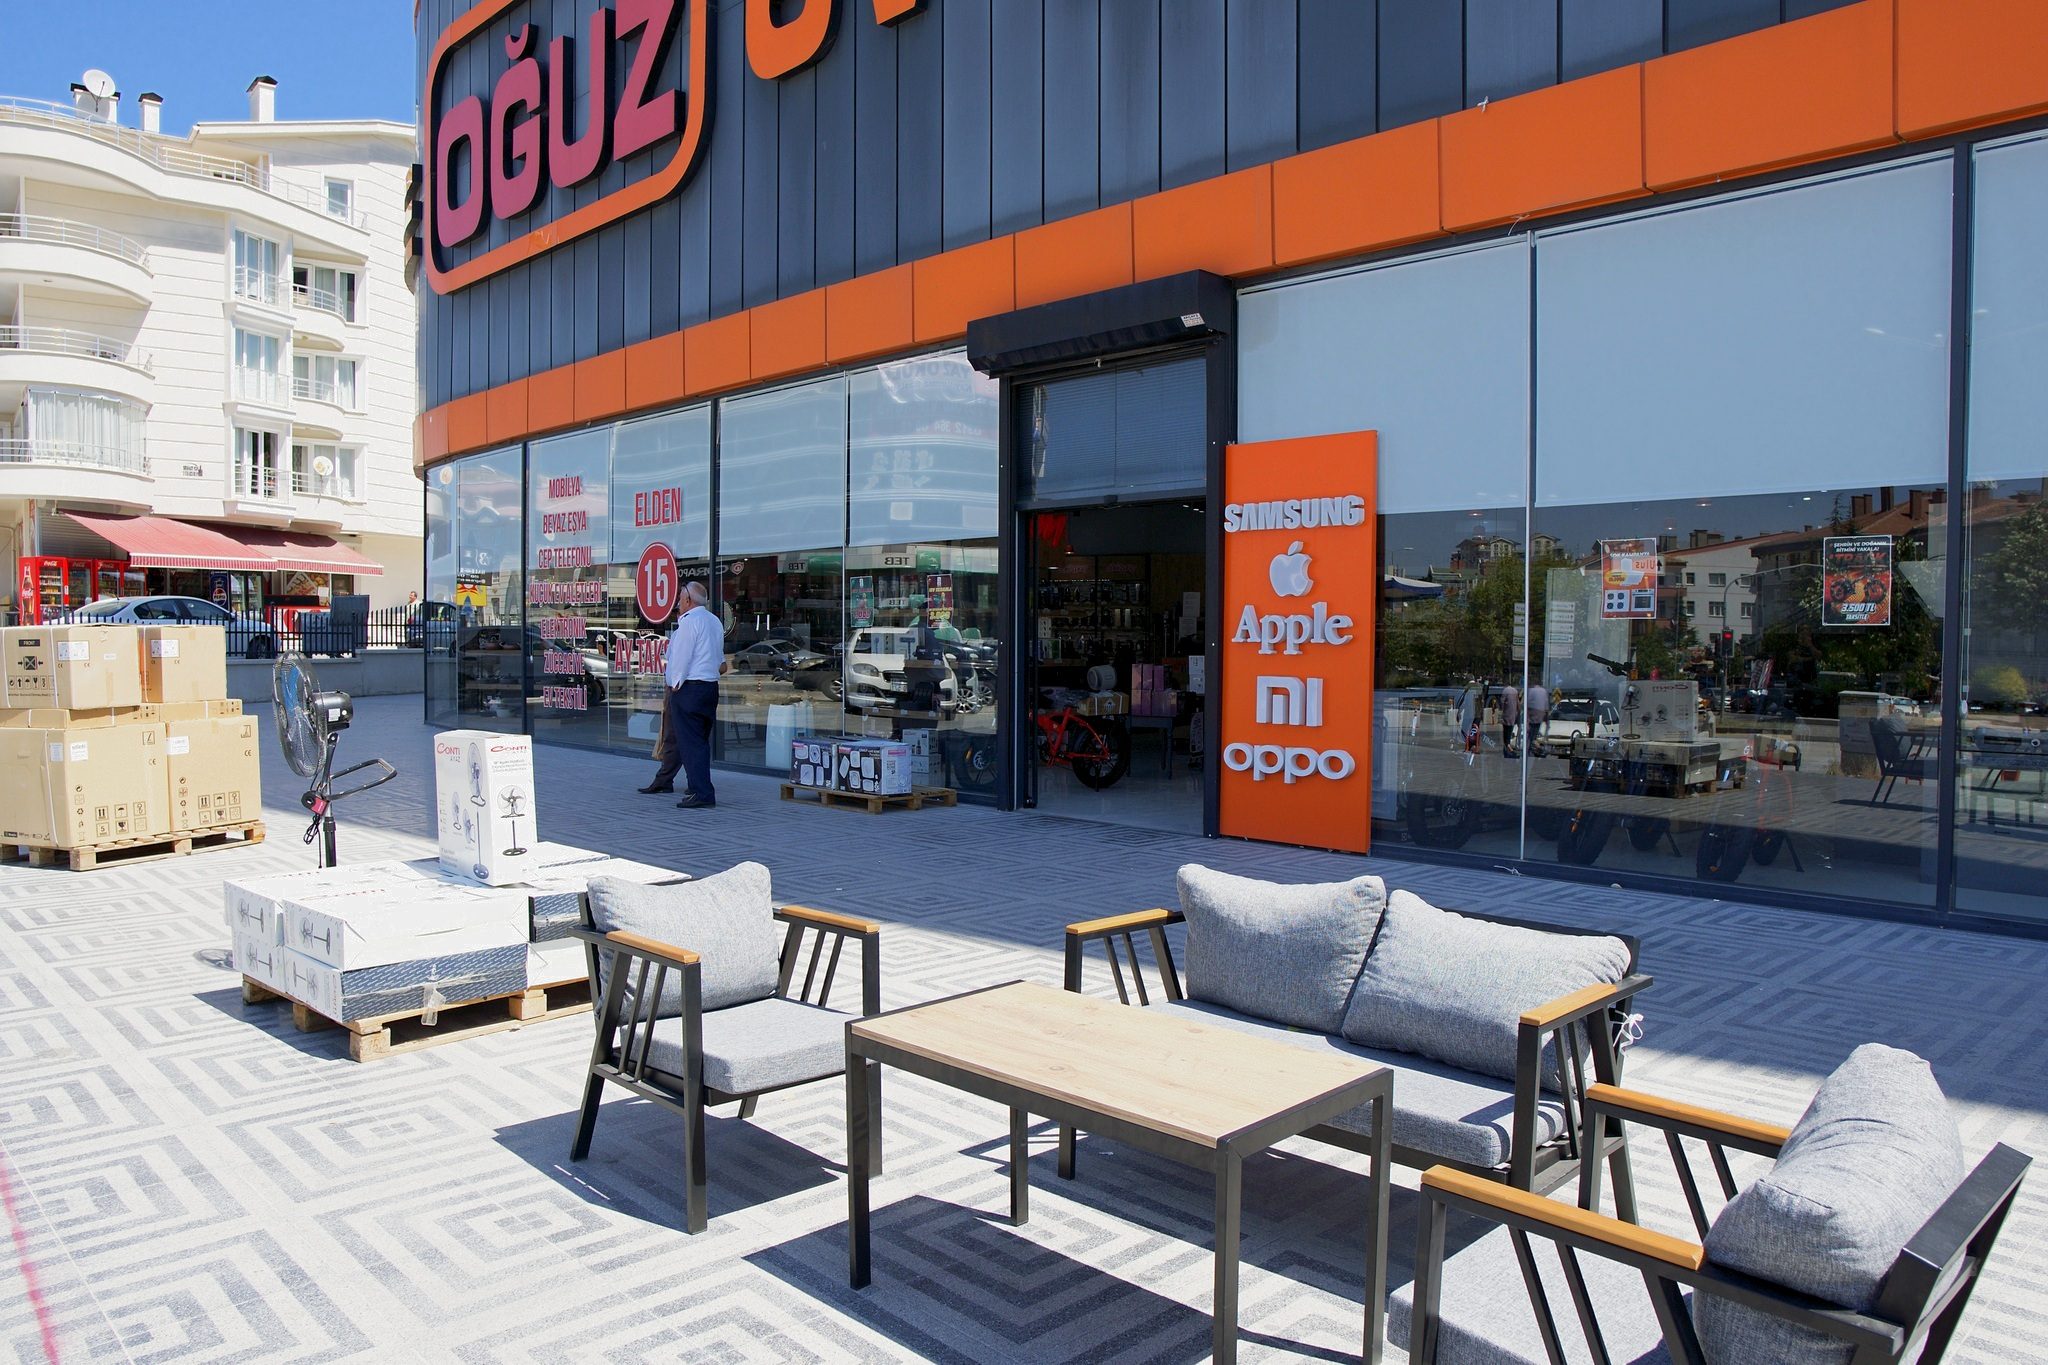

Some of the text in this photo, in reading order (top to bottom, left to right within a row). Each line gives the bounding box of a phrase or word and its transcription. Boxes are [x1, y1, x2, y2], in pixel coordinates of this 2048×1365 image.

[437, 0, 676, 248] OĞUZ
[548, 474, 581, 499] MOBİLYA
[543, 510, 587, 535] BEYAZ EŞYA
[634, 487, 681, 527] ELDEN
[1223, 495, 1365, 533] SAMSUNG
[538, 546, 592, 569] CEP TELEFONU
[644, 557, 668, 607] 15
[1231, 601, 1354, 656] Apple
[615, 638, 633, 672] AY
[437, 742, 461, 756] CONTI
[490, 745, 527, 753] CONTI
